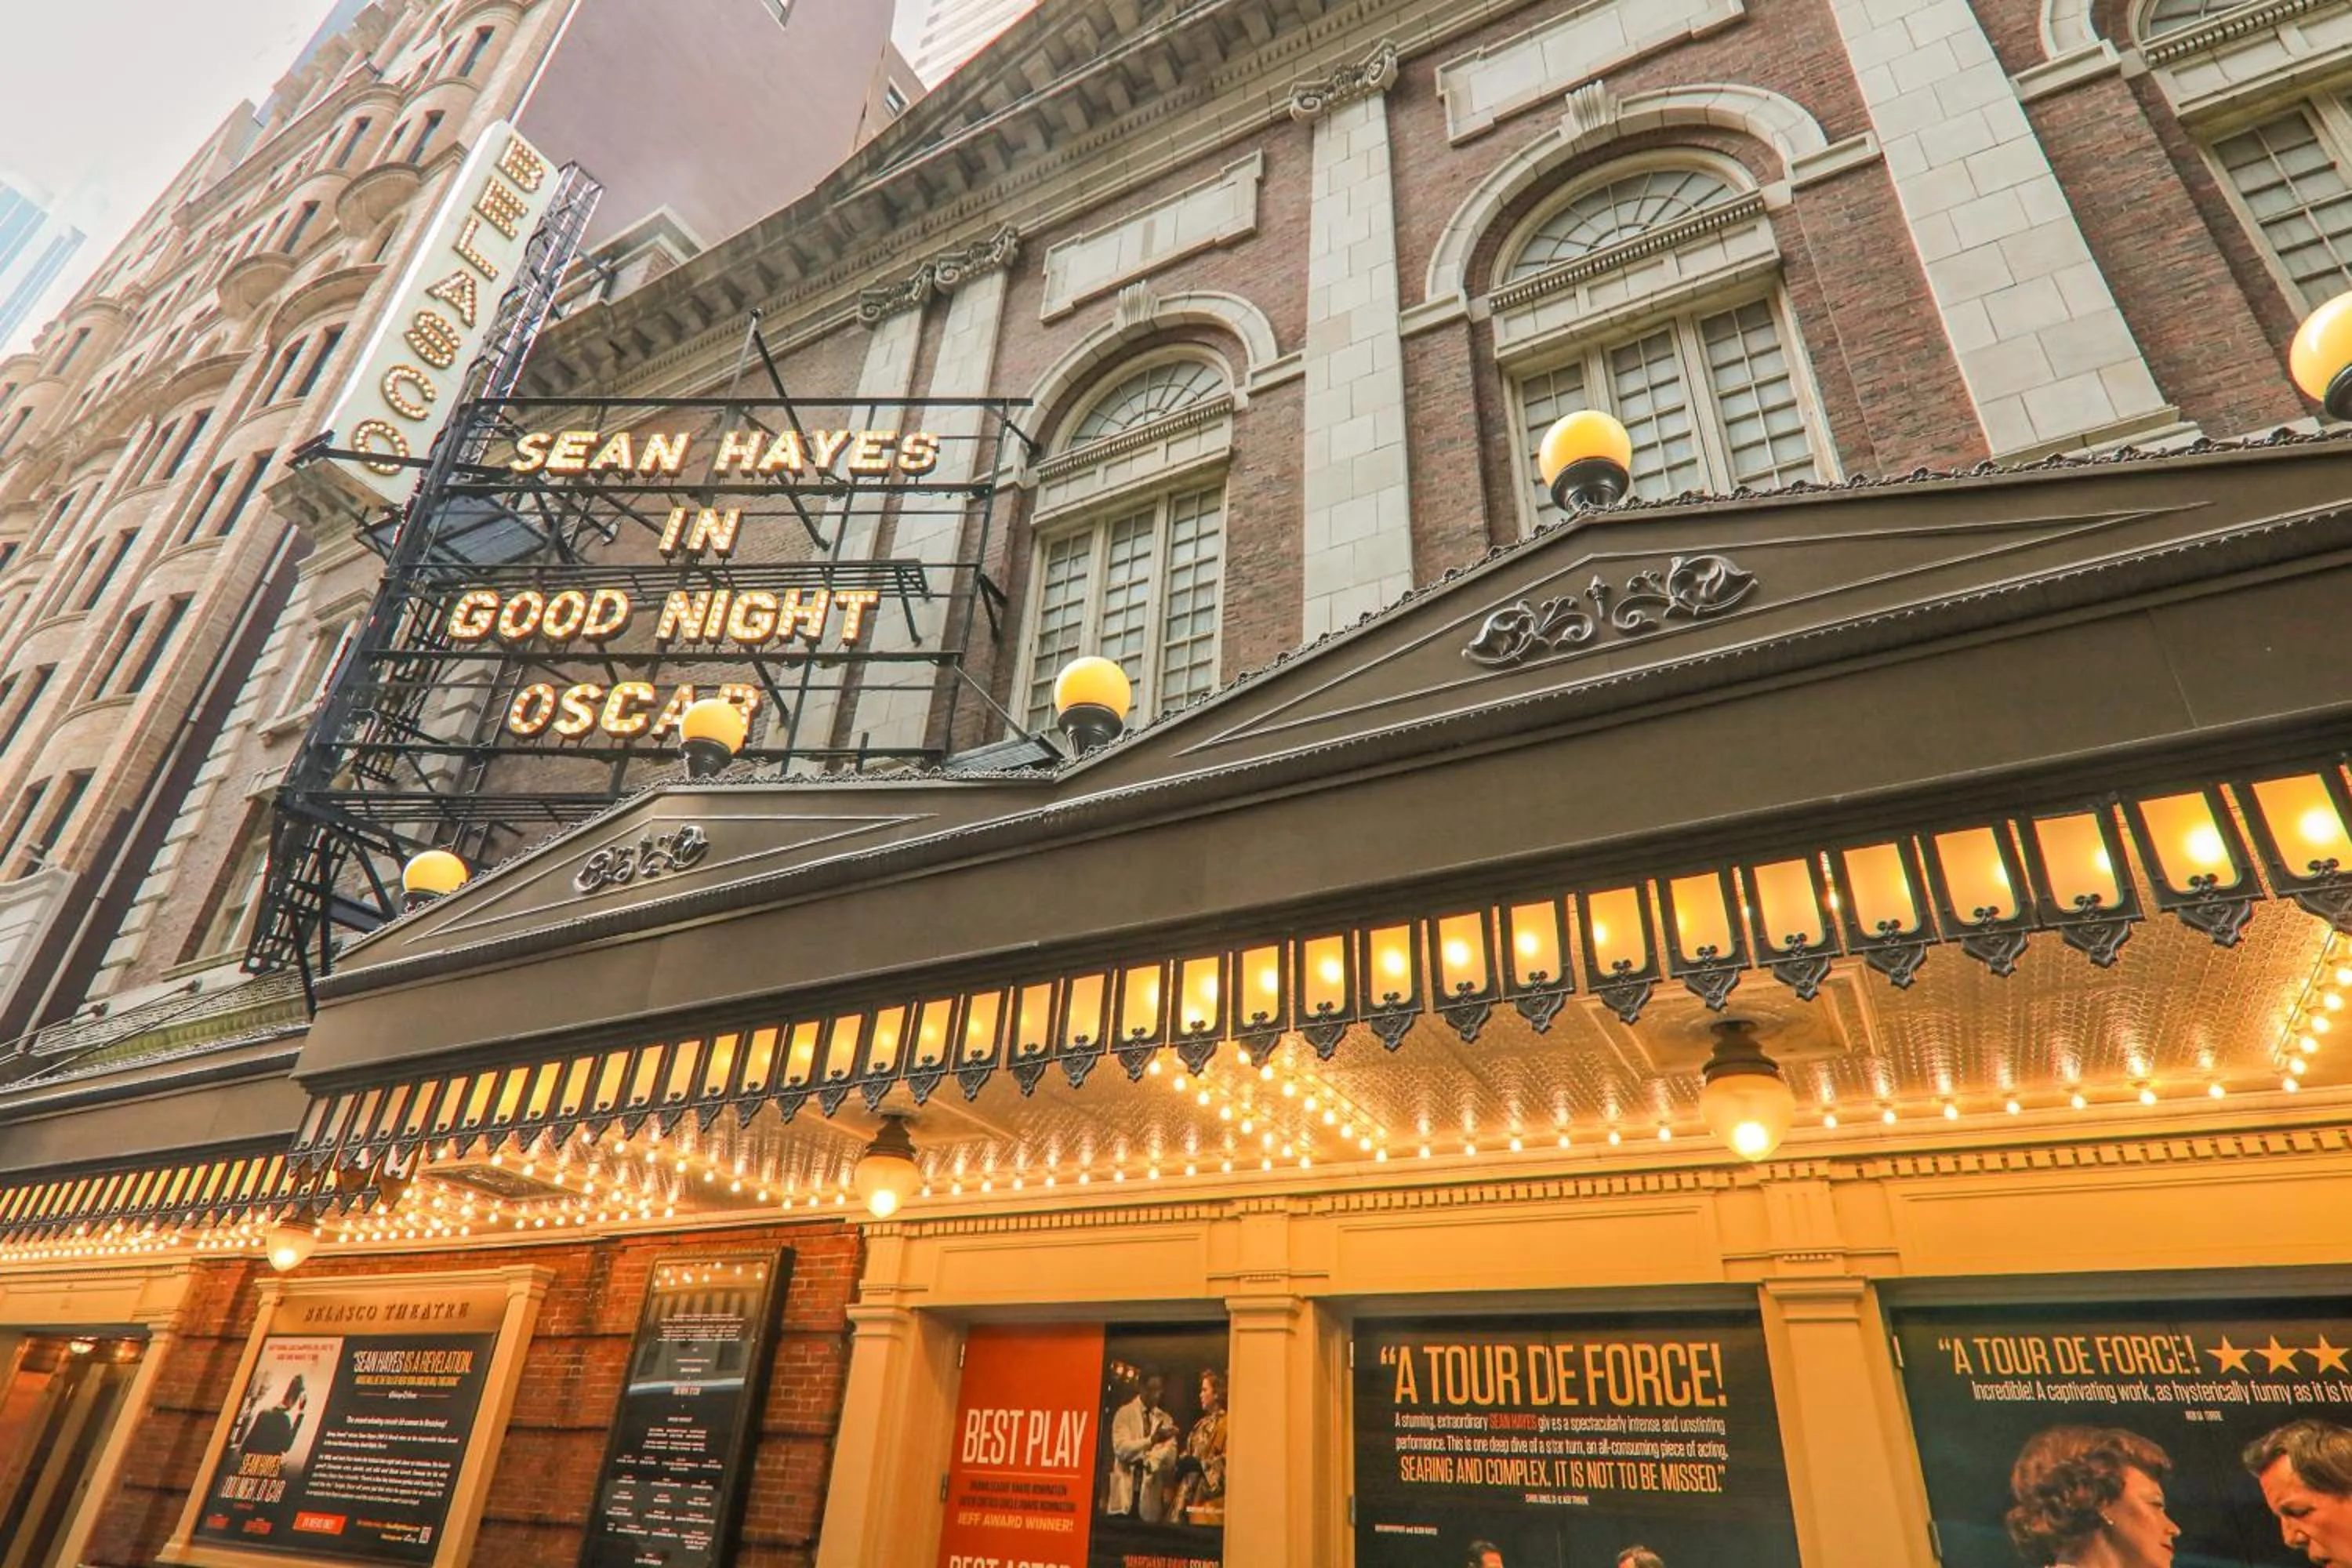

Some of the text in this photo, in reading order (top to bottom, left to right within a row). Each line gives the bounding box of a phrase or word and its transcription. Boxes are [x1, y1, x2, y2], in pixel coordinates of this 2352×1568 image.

[350, 136, 547, 475] BELASCO
[510, 430, 941, 478] SEAN HAYES
[659, 507, 742, 558] IN
[448, 589, 880, 645] GOOD NIGHT
[304, 1301, 470, 1322] BELASCO THEATRE
[1380, 1342, 1728, 1408] “A TOUR DE FORCE!
[1938, 1335, 2201, 1375] “A TOUR DE FORCE!
[1971, 1380, 2034, 1401] Incredible!
[2036, 1380, 2047, 1401] A
[2047, 1381, 2118, 1404] captivating
[2117, 1380, 2155, 1403] work,
[2156, 1384, 2172, 1401] as
[2172, 1380, 2252, 1405] hysterically
[2250, 1380, 2292, 1406] funny
[2293, 1384, 2314, 1402] as
[2310, 1381, 2325, 1402] it
[2323, 1381, 2341, 1402] is
[961, 1409, 1088, 1468] BEST PLAY
[1395, 1413, 1400, 1428] A
[1437, 1414, 1488, 1432] extraordinary
[1570, 1416, 1626, 1433] spectacularly
[1628, 1416, 1660, 1432] intense
[1661, 1416, 1679, 1432] and
[1396, 1435, 1446, 1450] performance.
[1447, 1436, 1463, 1451] This
[1465, 1436, 1472, 1451] is
[1473, 1438, 1488, 1452] one
[1490, 1436, 1508, 1454] deep
[1511, 1436, 1527, 1453] dive
[1530, 1437, 1537, 1454] of
[1545, 1439, 1564, 1454] star
[1586, 1441, 1597, 1454] an
[1599, 1439, 1660, 1458] all-consuming
[1661, 1440, 1686, 1458] piece
[1686, 1439, 1696, 1457] of
[1401, 1456, 1726, 1493] SEARING AND COMPLEX. IT IS NOT TO BE MISSED.”
[957, 1512, 1074, 1532] JEFF AWARD WINNER!
